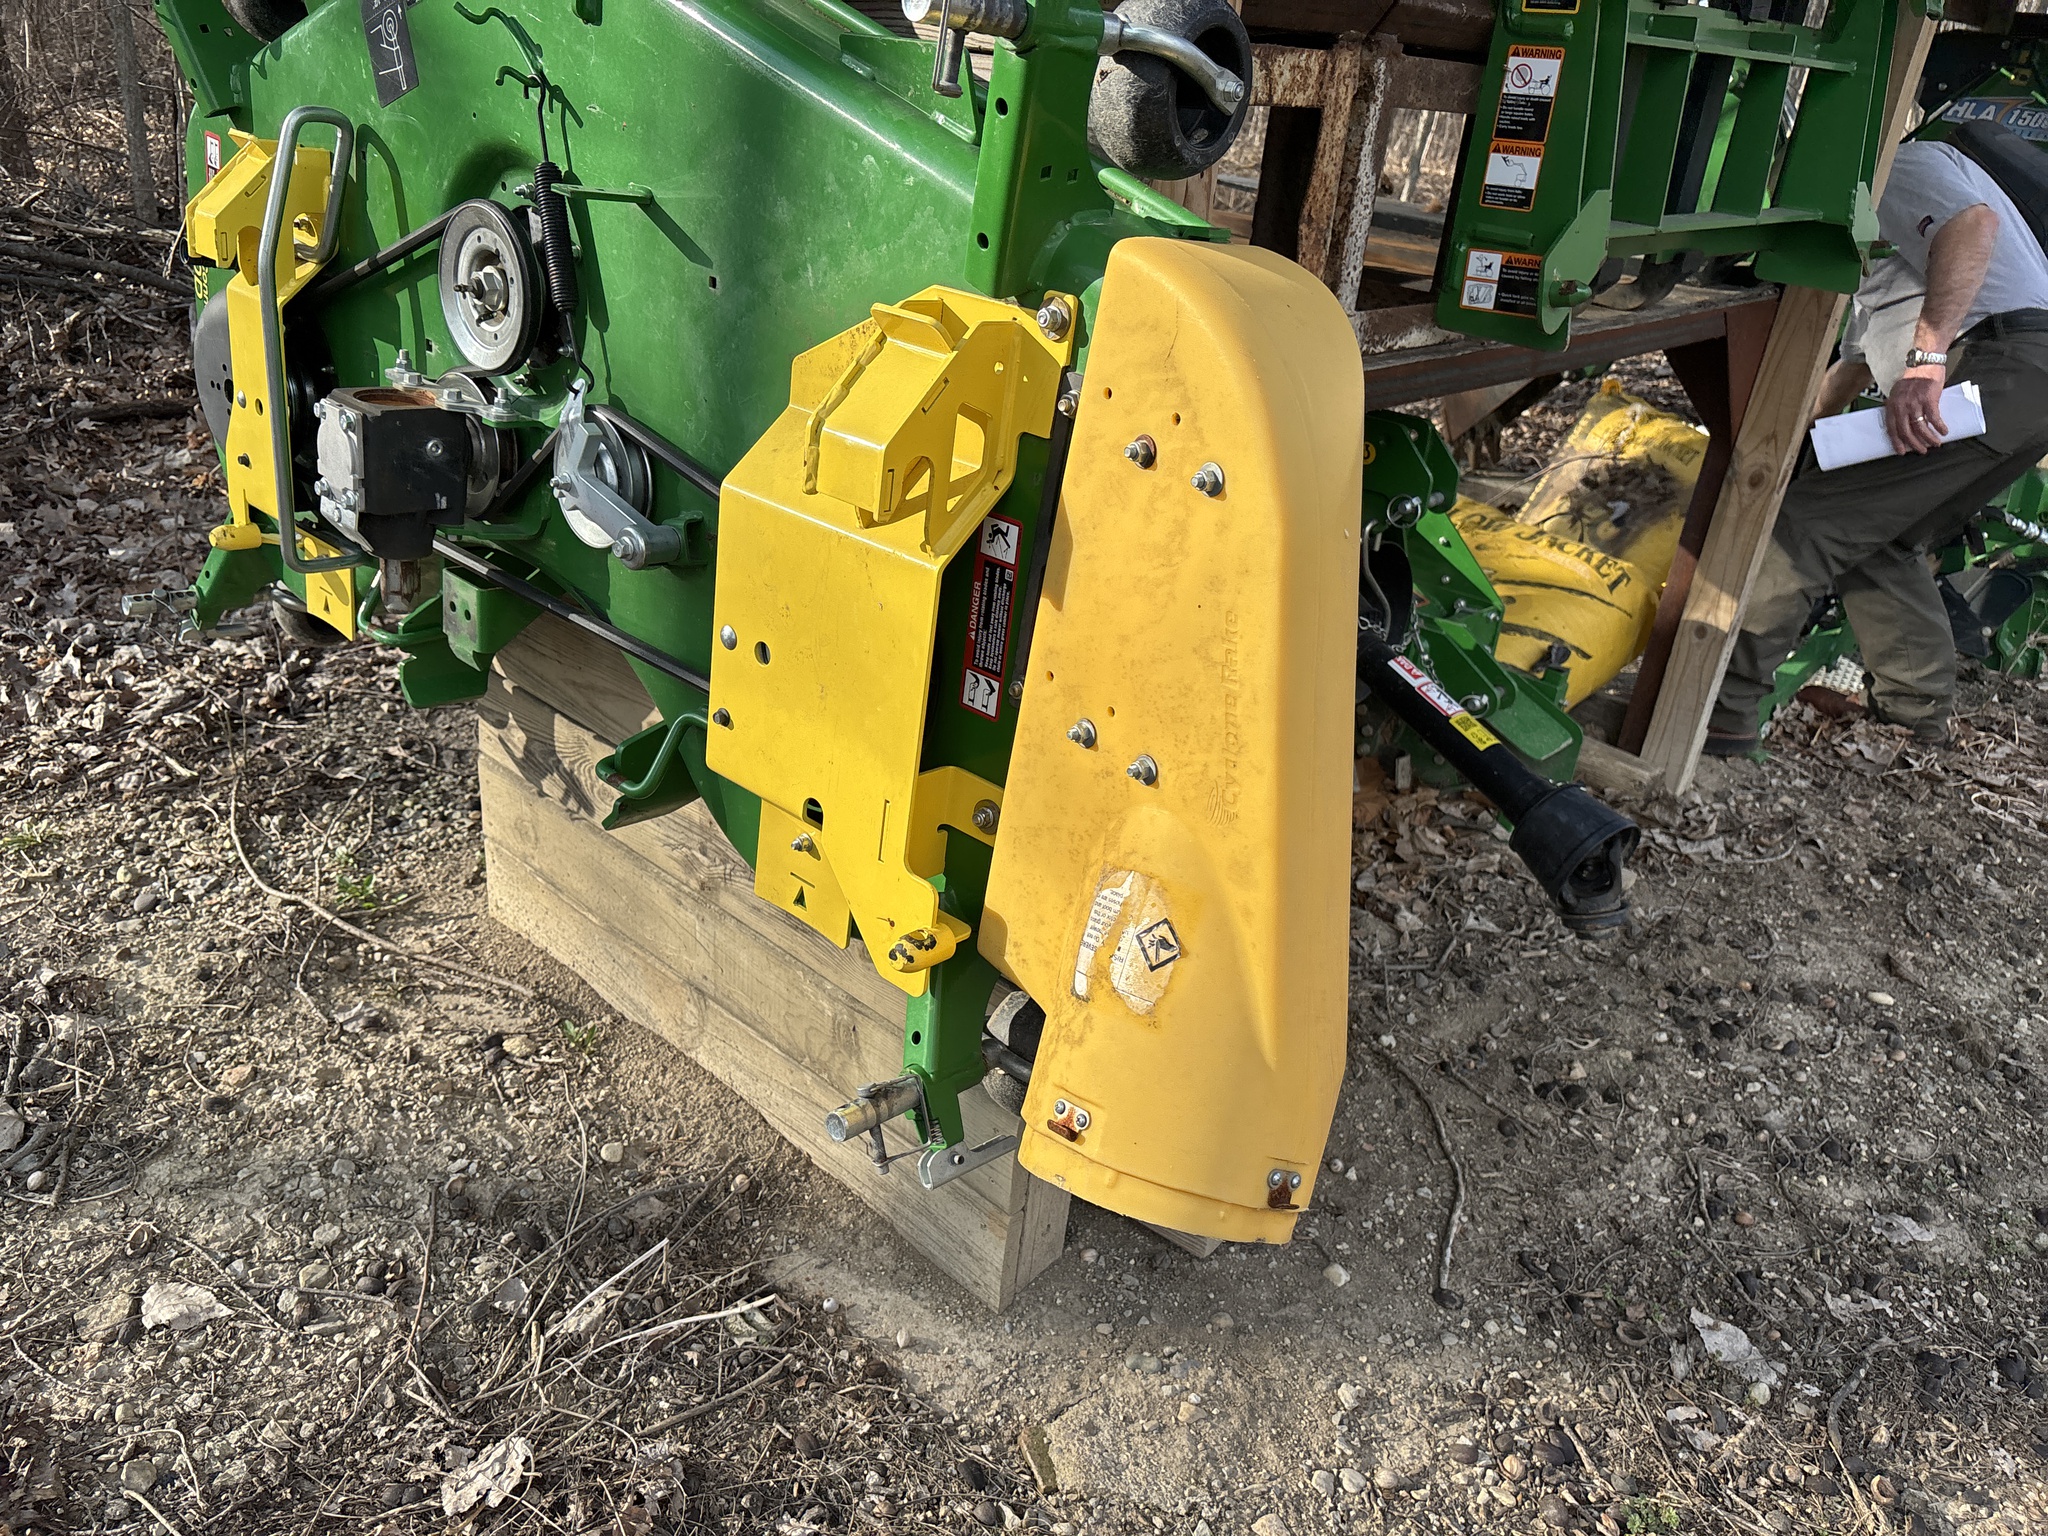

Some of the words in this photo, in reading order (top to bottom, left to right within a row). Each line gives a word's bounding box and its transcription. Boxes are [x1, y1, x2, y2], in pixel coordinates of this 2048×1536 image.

[1521, 48, 1562, 60] WARNING
[1947, 101, 1996, 120] HLA
[1502, 145, 1542, 157] WARNING
[970, 581, 981, 629] DANGER
[1221, 611, 1239, 684] Rake
[1222, 693, 1241, 809] Cyclone
